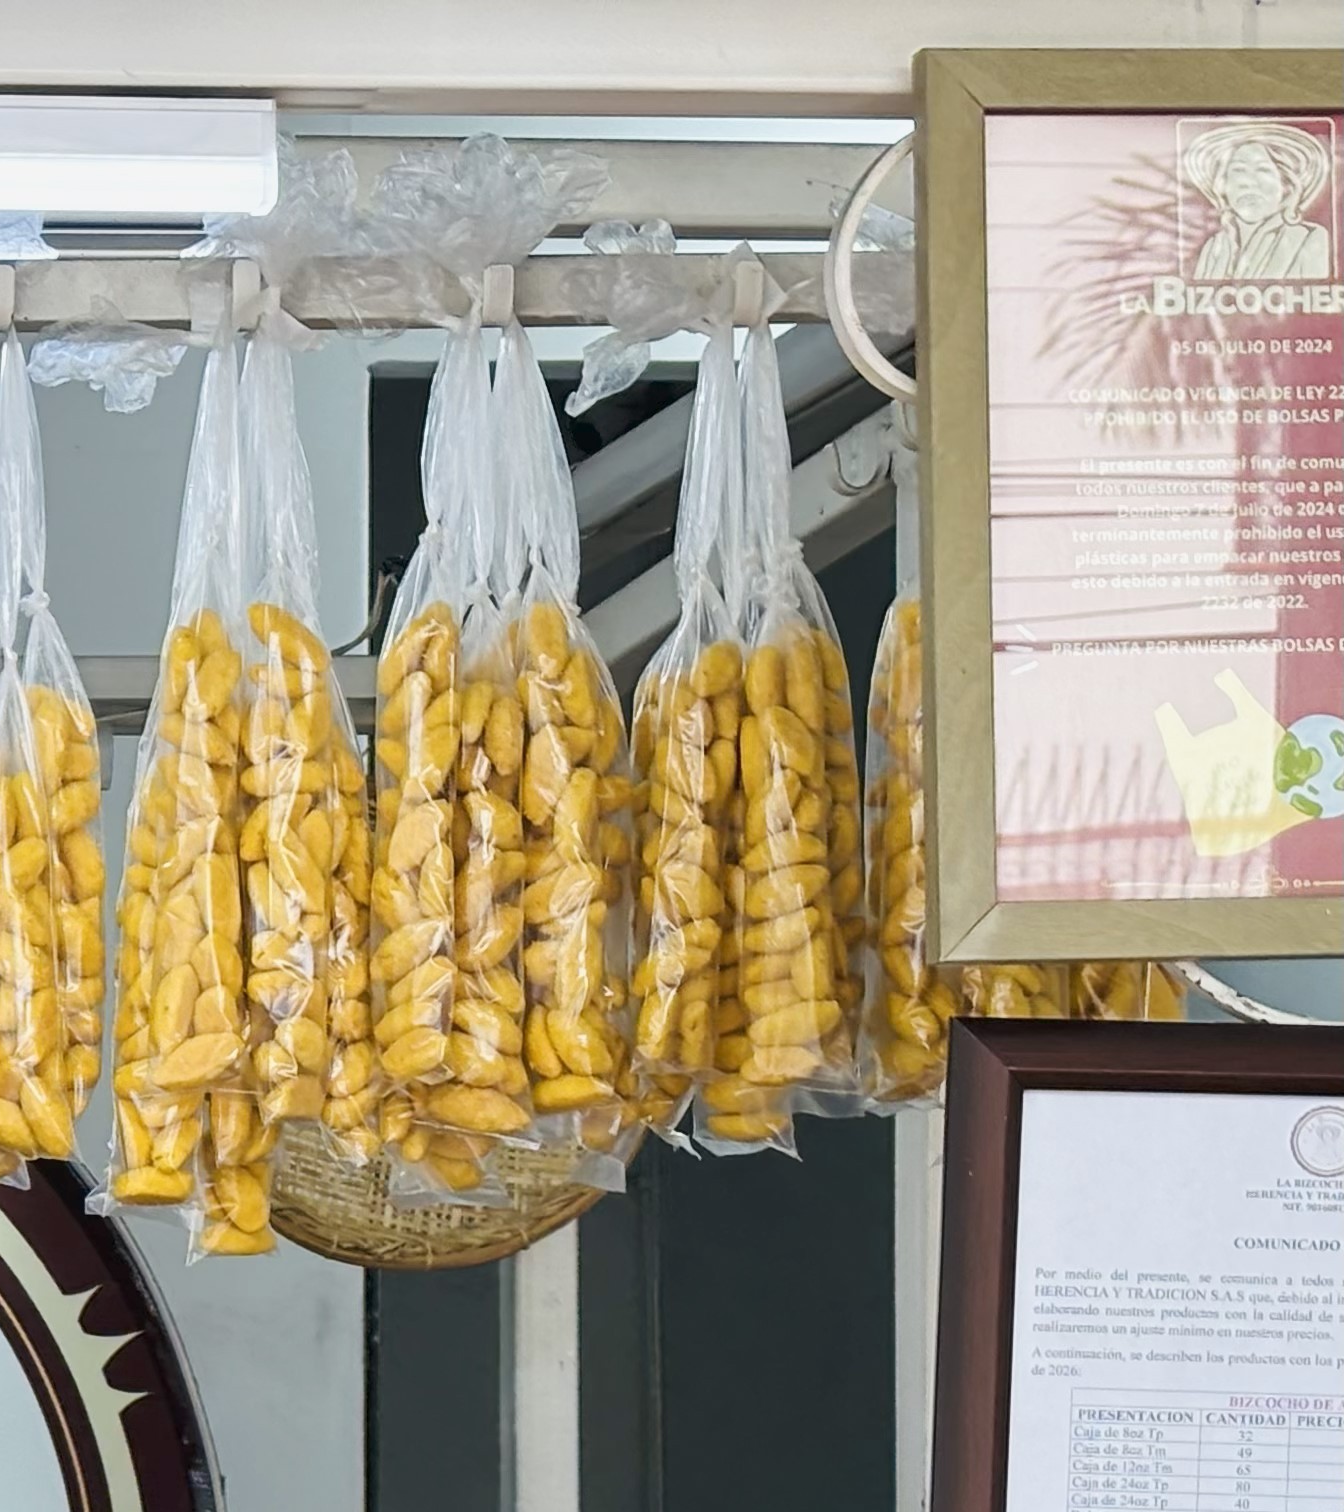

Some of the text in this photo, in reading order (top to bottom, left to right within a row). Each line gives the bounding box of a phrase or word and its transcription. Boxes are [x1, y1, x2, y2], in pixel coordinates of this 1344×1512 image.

[1119, 294, 1151, 314] LA
[1196, 340, 1332, 356] DE JULIO DE 2024
[1068, 386, 1325, 403] COMUNICADO VIGENCIA DE LEY
[1084, 409, 1330, 426] PROHIBIDO EL USO DE BOLSAS
[1099, 459, 1171, 474] presente
[1177, 459, 1193, 471] es
[1198, 458, 1226, 471] con
[1232, 456, 1246, 470] el
[1251, 456, 1274, 470] fin
[1277, 456, 1296, 469] de
[1076, 482, 1121, 496] todos
[1127, 482, 1197, 494] nuestros
[1274, 482, 1305, 496] que
[1310, 482, 1319, 491] a
[1117, 504, 1190, 520] Domingo
[1273, 503, 1292, 516] de
[1297, 502, 1333, 515] 2024
[1073, 525, 1321, 543] terminantemente prohibido el
[1075, 550, 1341, 568] plásticas para empacar nuestros
[1072, 573, 1294, 589] esto debido a la entrada en
[1242, 595, 1309, 609] de 2022.
[1051, 641, 1141, 657] PREGUNTA
[1145, 640, 1182, 655] POR
[1185, 639, 1268, 654] NUESTRAS
[1271, 638, 1334, 652] BOLSAS
[1277, 1179, 1291, 1188] LA
[1246, 1190, 1316, 1200] HERENCIA Y
[1234, 1237, 1340, 1251] COMUNICADO
[1035, 1268, 1056, 1279] Por
[1065, 1268, 1102, 1280] medio
[1110, 1269, 1128, 1281] del
[1137, 1272, 1190, 1284] presente,
[1199, 1274, 1212, 1283] se
[1220, 1273, 1278, 1285] comunica
[1286, 1277, 1292, 1285] a
[1302, 1275, 1334, 1287] todos
[1035, 1285, 1108, 1298] HERENCIA
[1112, 1288, 1122, 1298] Y
[1126, 1287, 1206, 1301] TRADICION
[1277, 1292, 1318, 1304] debido
[1322, 1293, 1332, 1304] al
[1033, 1302, 1099, 1315] elaborando
[1105, 1307, 1155, 1317] nuestros
[1161, 1307, 1219, 1320] productos
[1225, 1310, 1246, 1319] con
[1253, 1308, 1263, 1320] la
[1269, 1310, 1312, 1321] calidad
[1319, 1311, 1333, 1322] de
[1033, 1321, 1284, 1339] realizaremos un ajuste en nuestros
[1032, 1347, 1041, 1358] A
[1130, 1353, 1142, 1361] se
[1146, 1350, 1201, 1362] describen
[1207, 1350, 1224, 1363] los
[1228, 1353, 1285, 1366] productos
[1289, 1356, 1311, 1366] con
[1315, 1354, 1332, 1366] los
[1031, 1365, 1045, 1376] de
[1229, 1396, 1309, 1409] BIZCOCHO
[1314, 1398, 1333, 1410] DE
[1078, 1409, 1286, 1425] PRESENTACION CANTIDAD
[1074, 1425, 1101, 1440] Caja
[1104, 1427, 1119, 1437] de
[1103, 1444, 1119, 1454] de
[1238, 1448, 1252, 1458] 49
[1103, 1461, 1117, 1471] de
[1236, 1464, 1251, 1475] 65
[1102, 1478, 1117, 1488] de
[1101, 1495, 1116, 1505] de
